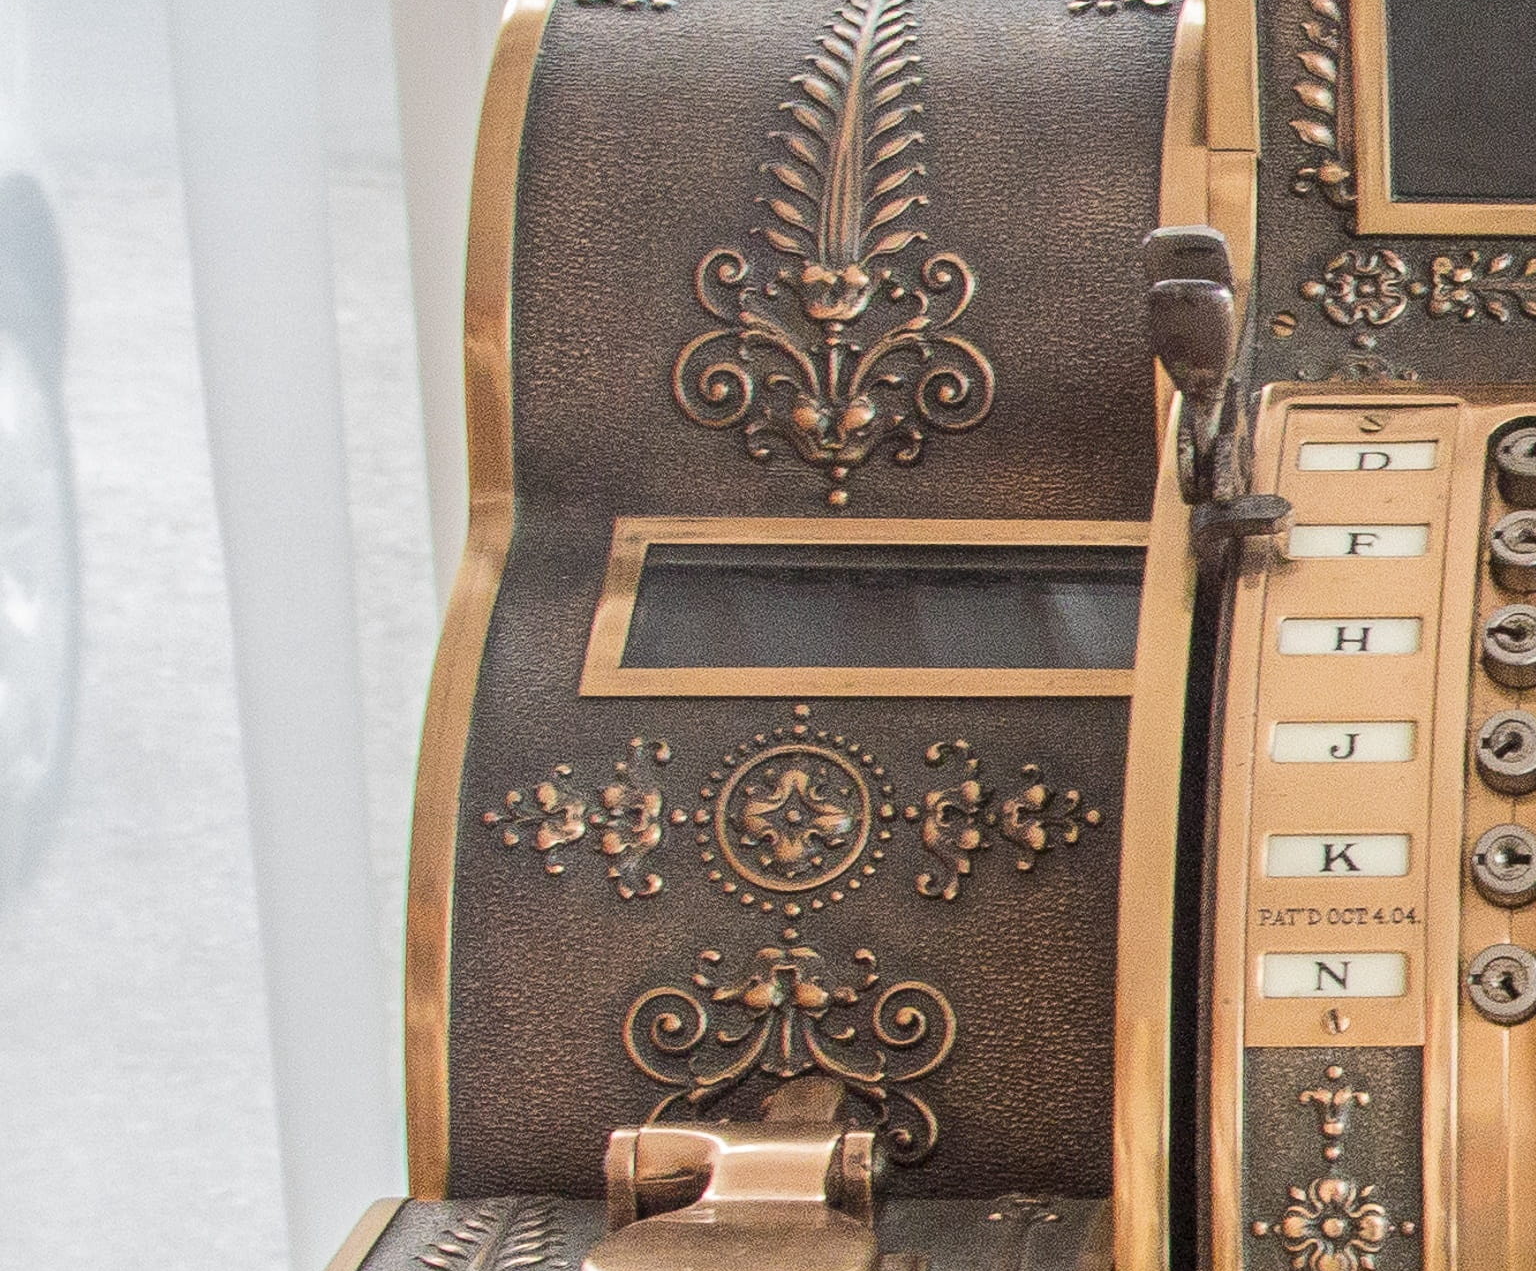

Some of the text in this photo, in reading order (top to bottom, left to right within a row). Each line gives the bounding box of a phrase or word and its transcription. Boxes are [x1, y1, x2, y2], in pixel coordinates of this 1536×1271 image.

[1357, 451, 1391, 471] D
[1346, 532, 1380, 555] F
[1333, 626, 1371, 652] H
[1330, 733, 1361, 759] J
[1319, 842, 1361, 872] K
[1313, 961, 1351, 991] N
